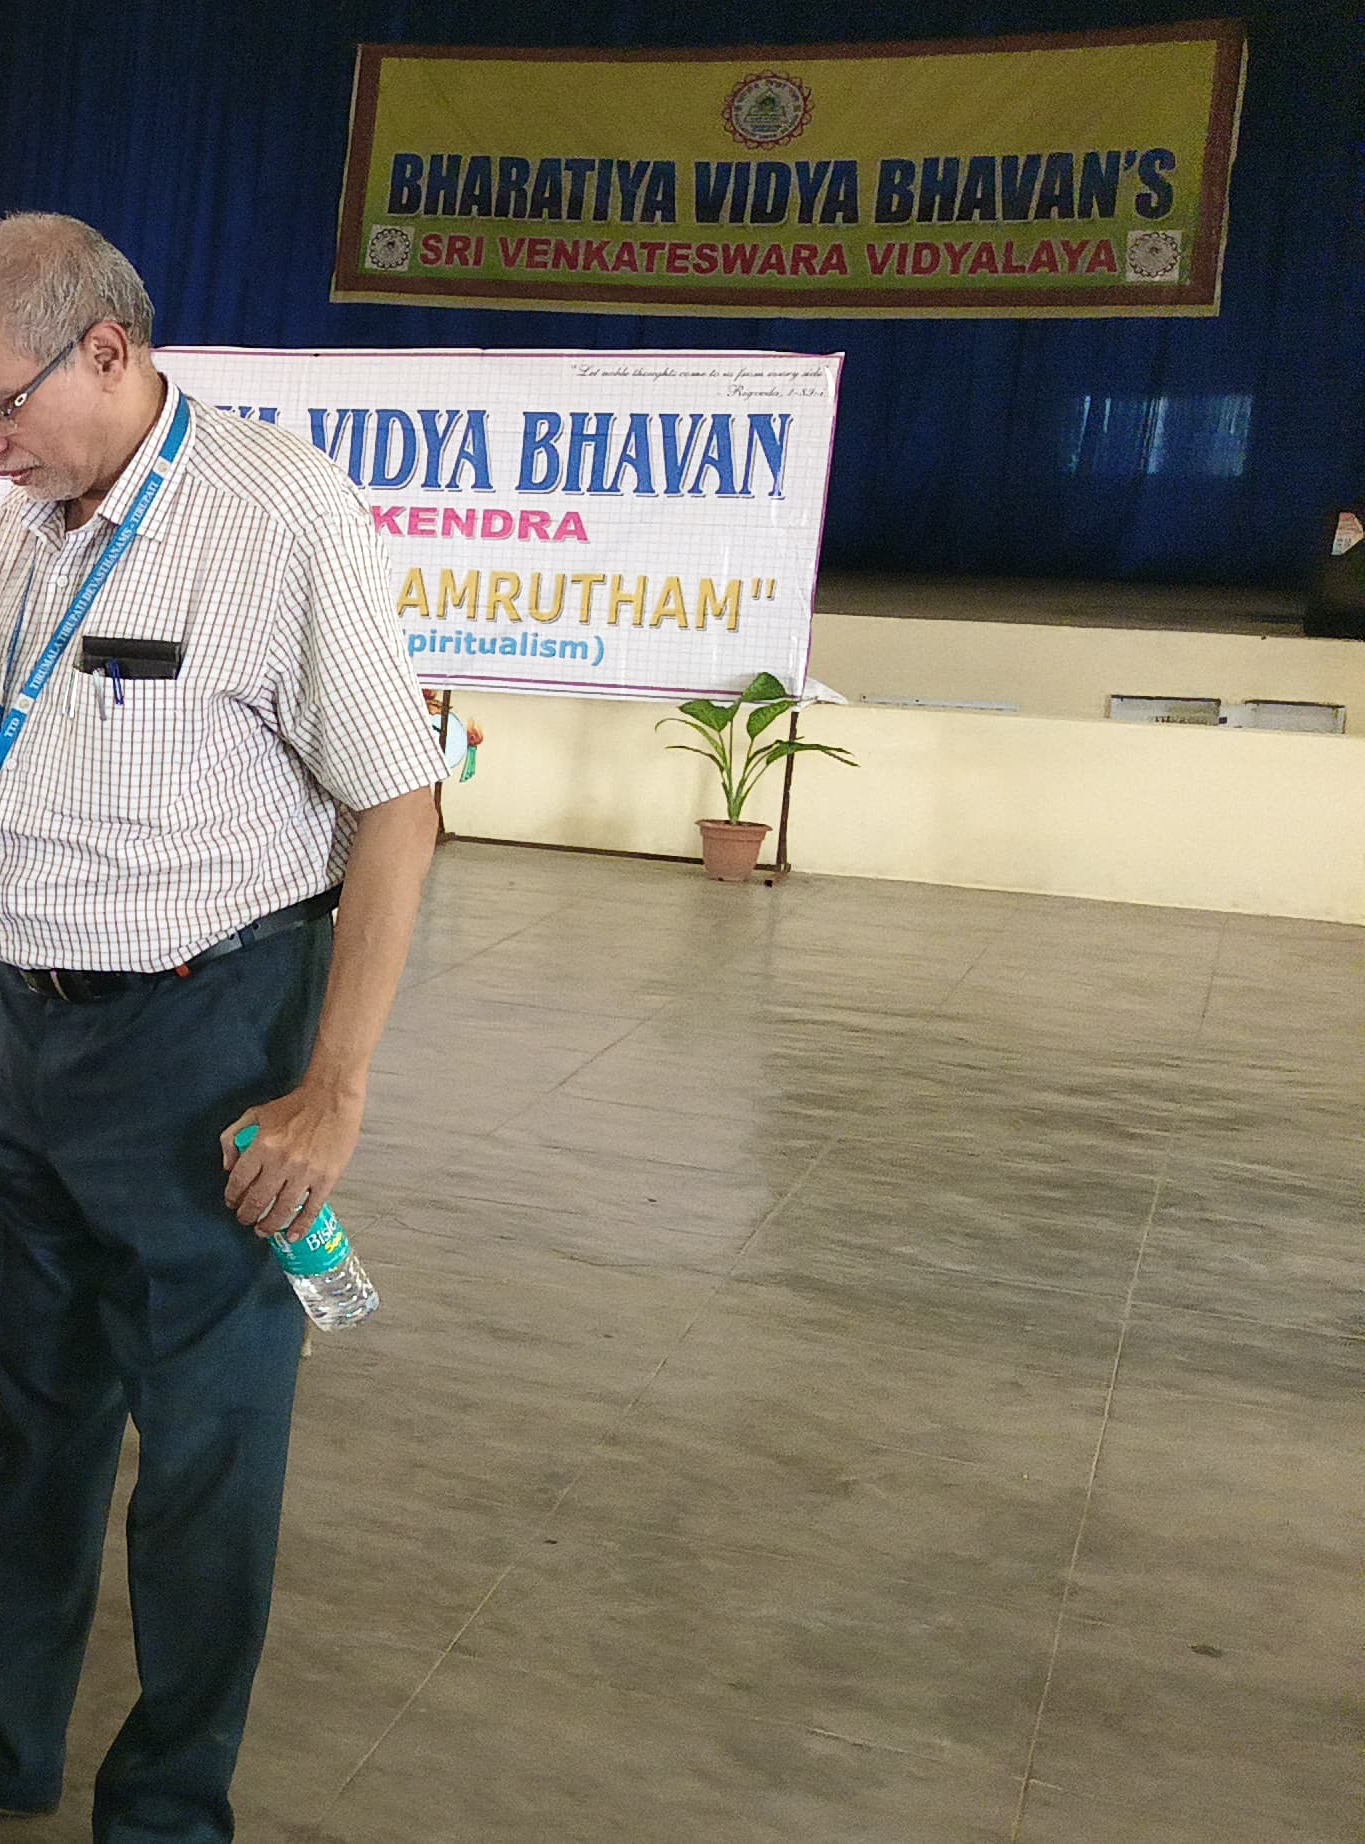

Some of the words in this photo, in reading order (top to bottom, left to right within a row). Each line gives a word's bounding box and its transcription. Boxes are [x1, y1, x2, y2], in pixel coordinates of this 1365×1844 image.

[387, 152, 677, 224] BHARATIYA
[693, 159, 860, 225] VIDYA
[874, 147, 1176, 224] BHAVAN'S
[420, 234, 485, 268] SRI
[498, 236, 848, 276] VENKATESWARA
[866, 239, 1118, 275] VIDYALAYA
[307, 407, 494, 492] VIDYA
[515, 411, 795, 499] BHAVAN
[372, 505, 589, 543] KENDRA
[29, 642, 63, 692] TIRUMALA
[57, 600, 89, 644] TIRUPATI
[81, 527, 133, 602] DEVASTHANAMS
[130, 481, 159, 524] TIRUPATI
[397, 568, 776, 633] AMRUTHAM"
[402, 628, 606, 668] piritualism)
[305, 1212, 338, 1252] Bisle
